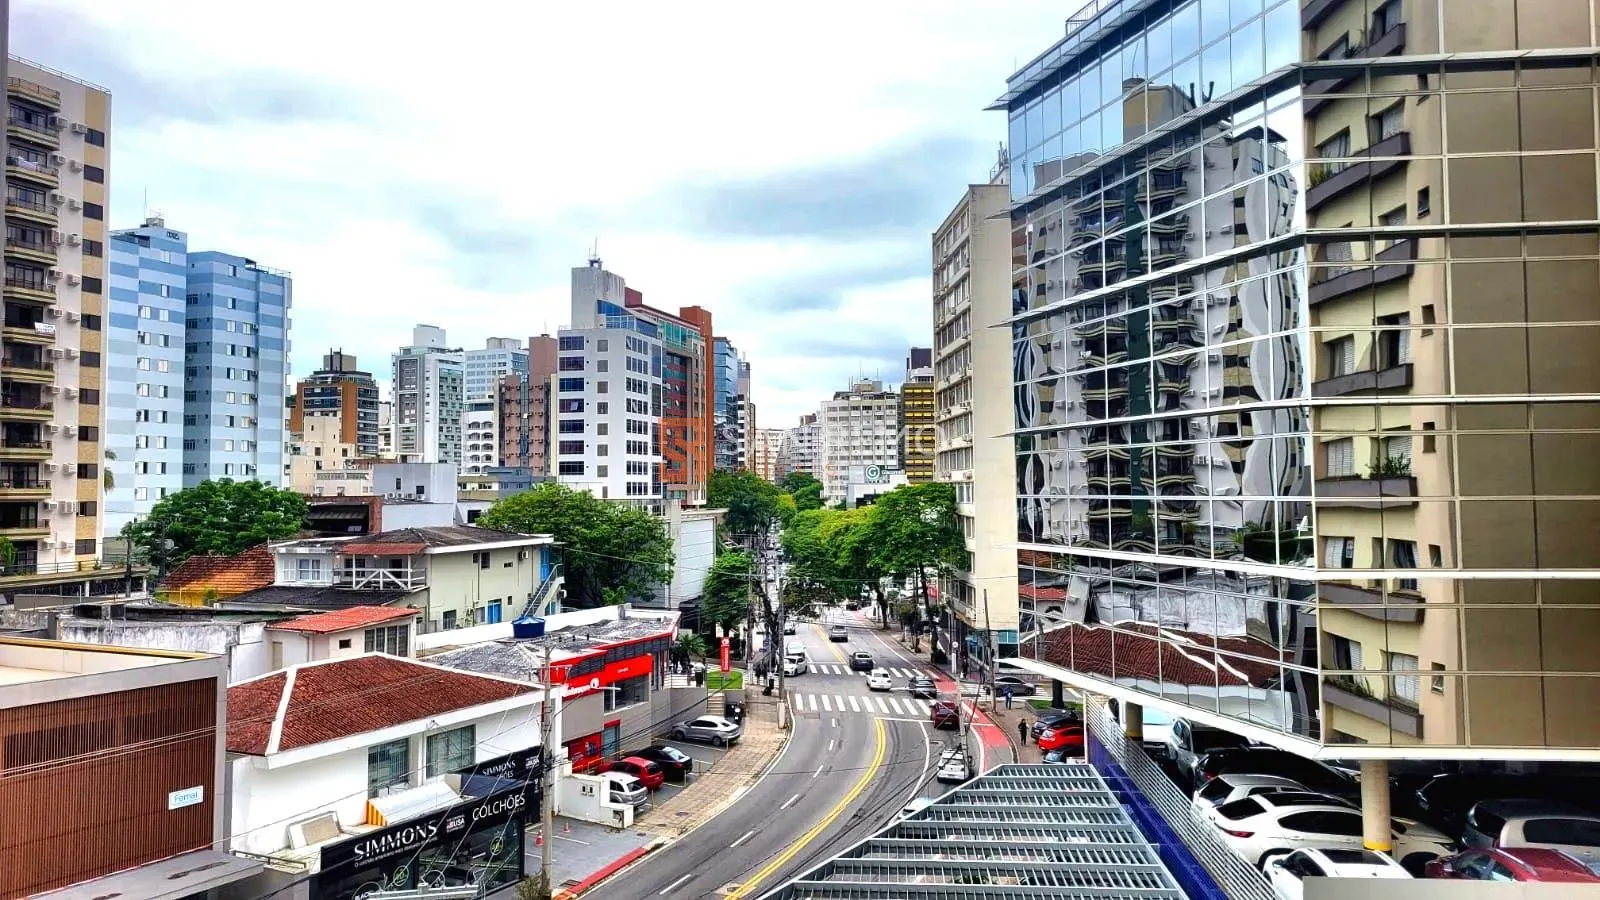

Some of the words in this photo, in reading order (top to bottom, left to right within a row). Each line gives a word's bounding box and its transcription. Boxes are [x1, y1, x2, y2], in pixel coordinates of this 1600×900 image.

[482, 760, 516, 776] SIMMONS
[472, 793, 526, 821] COLCHÕES
[354, 819, 437, 862] SIMMONS
